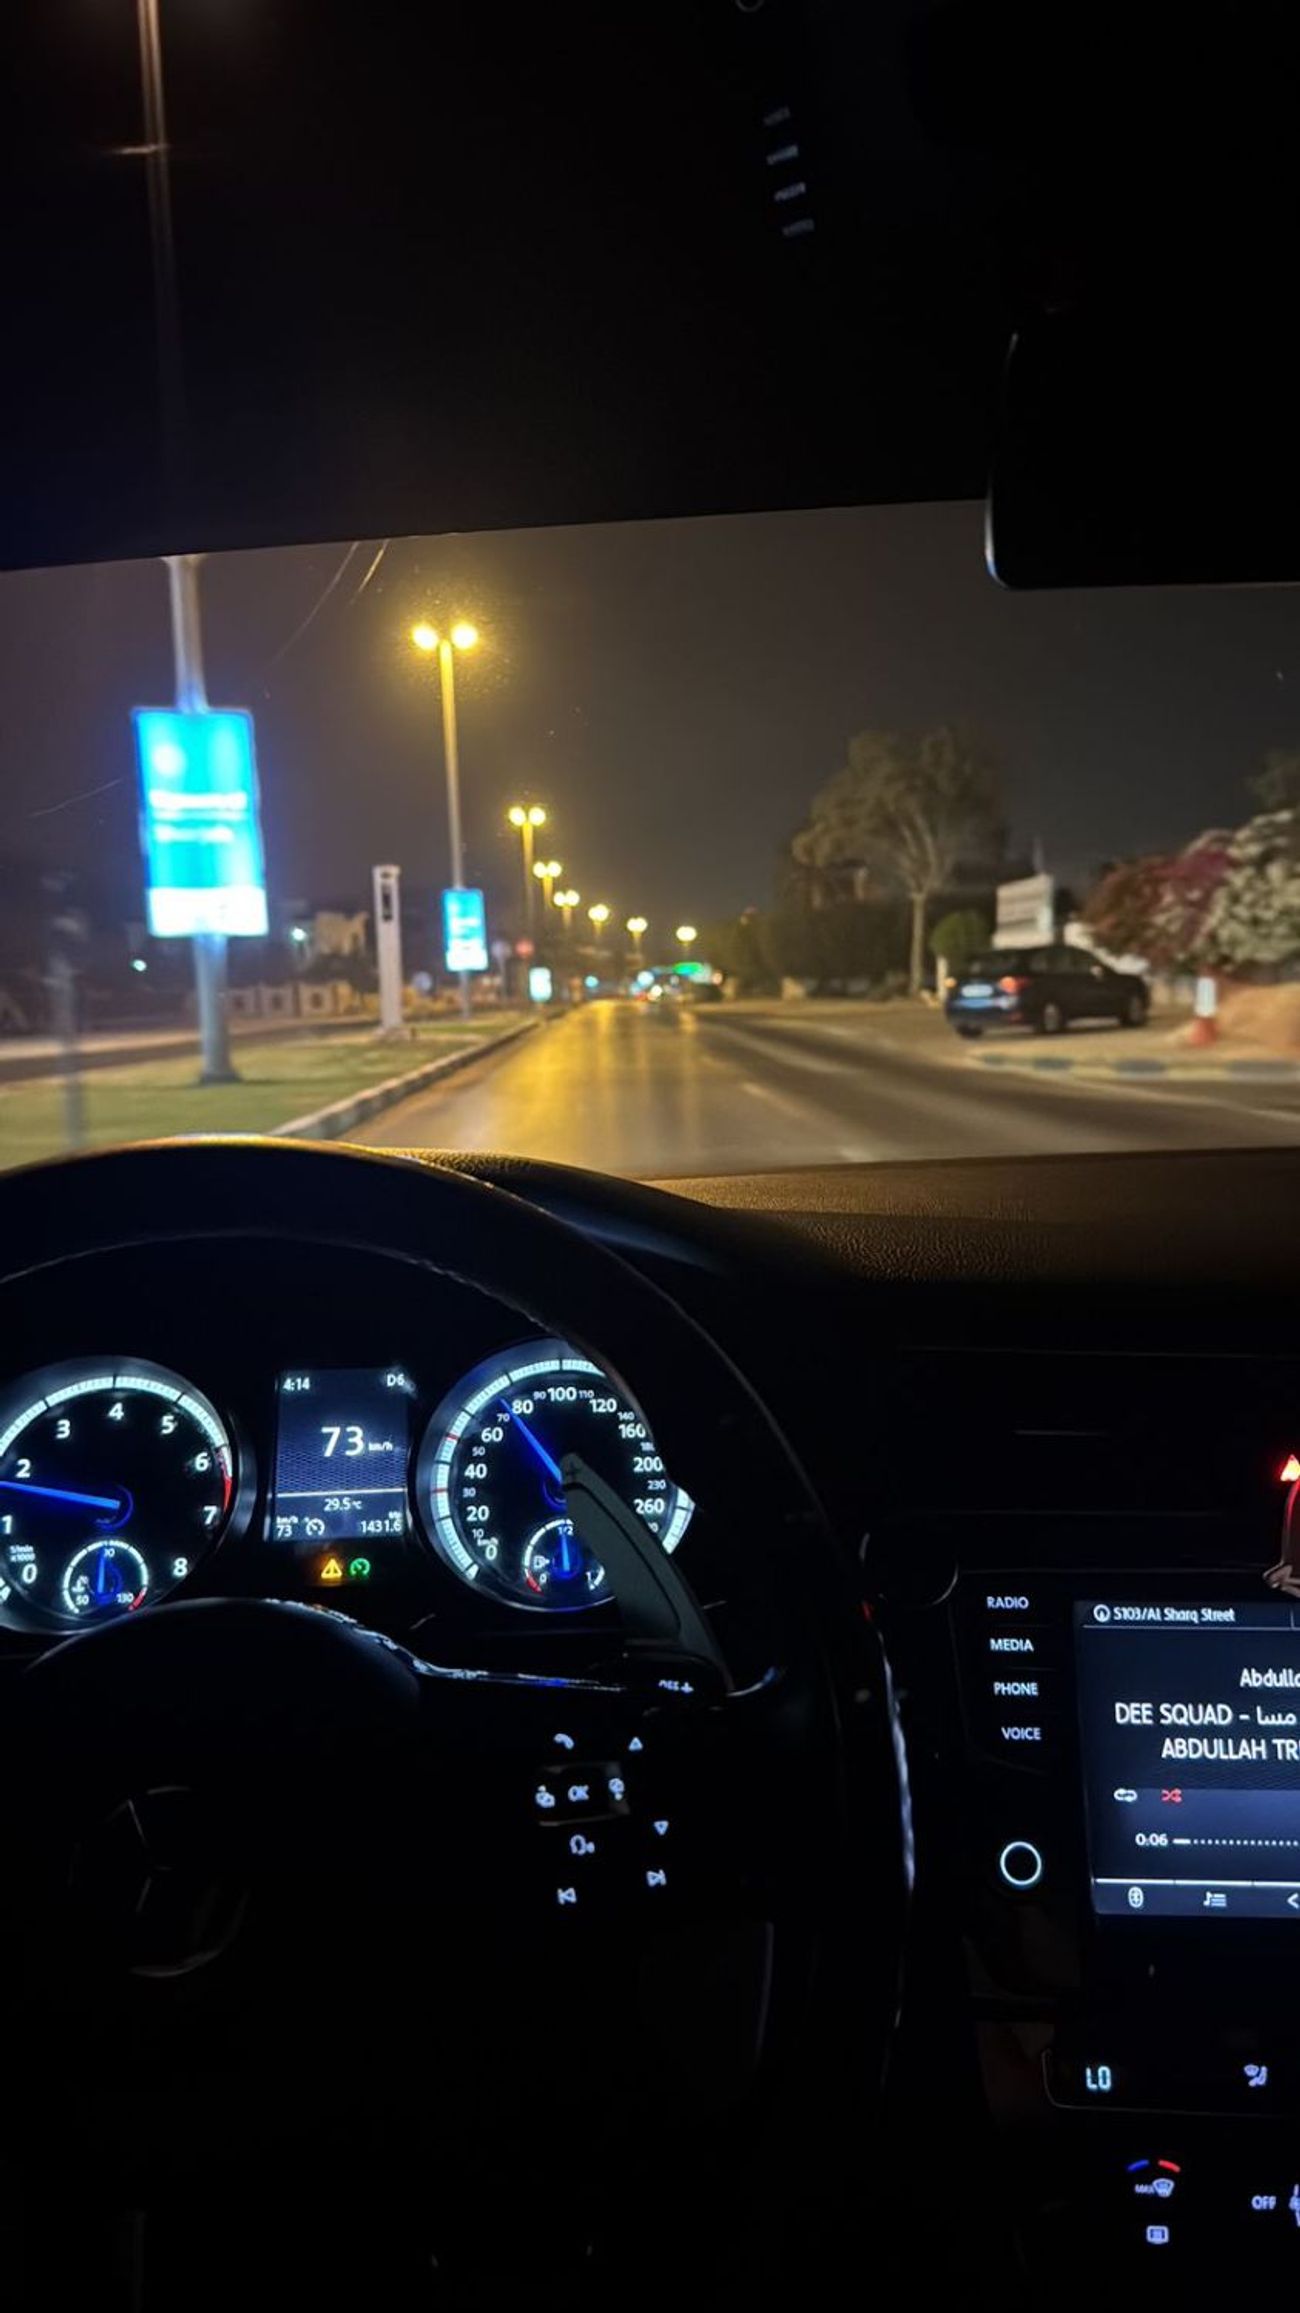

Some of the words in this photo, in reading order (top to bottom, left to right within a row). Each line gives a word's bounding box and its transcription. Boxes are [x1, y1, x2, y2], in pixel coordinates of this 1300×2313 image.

[283, 1377, 310, 1391] 4:14
[547, 1387, 577, 1401] 100
[578, 1390, 594, 1399] 110
[109, 1403, 124, 1420] 4
[512, 1400, 534, 1414] 80
[590, 1398, 618, 1413] 120
[161, 1415, 176, 1434] 5
[497, 1413, 510, 1423] 70
[56, 1420, 71, 1439] 3
[481, 1427, 503, 1442] 60
[619, 1423, 645, 1438] 160
[321, 1426, 364, 1457] 73
[368, 1441, 393, 1451] km/h
[472, 1446, 486, 1457] 50
[16, 1459, 31, 1478] 2
[194, 1452, 209, 1471] 6
[633, 1457, 663, 1473] 200
[464, 1463, 487, 1479] 40
[647, 1479, 666, 1490] 230
[466, 1505, 489, 1521] 20
[634, 1499, 664, 1514] 260
[203, 1505, 217, 1525] 7
[1, 1515, 13, 1534] 1
[276, 1525, 292, 1537] 73
[473, 1528, 484, 1539] 10
[486, 1544, 497, 1561] 0
[21, 1563, 37, 1584] 0
[172, 1557, 188, 1578] 8
[540, 1573, 547, 1584] 0
[76, 1595, 89, 1605] 50
[987, 1596, 1029, 1609] RADIO
[1164, 1607, 1199, 1624] Sharq
[1201, 1608, 1235, 1622] Street
[990, 1638, 1034, 1652] MEDIA
[993, 1682, 1039, 1696] PHONE
[1115, 1702, 1153, 1724] DEE
[1160, 1703, 1233, 1725] SQUAD
[1001, 1727, 1041, 1740] VOICE
[1161, 1738, 1267, 1759] ABDULLAH
[1272, 1739, 1300, 1760] TR
[568, 1785, 589, 1802] OK
[1135, 1833, 1168, 1846] 0:06
[1086, 2066, 1111, 2090] LO
[1251, 2196, 1276, 2210] OFF
